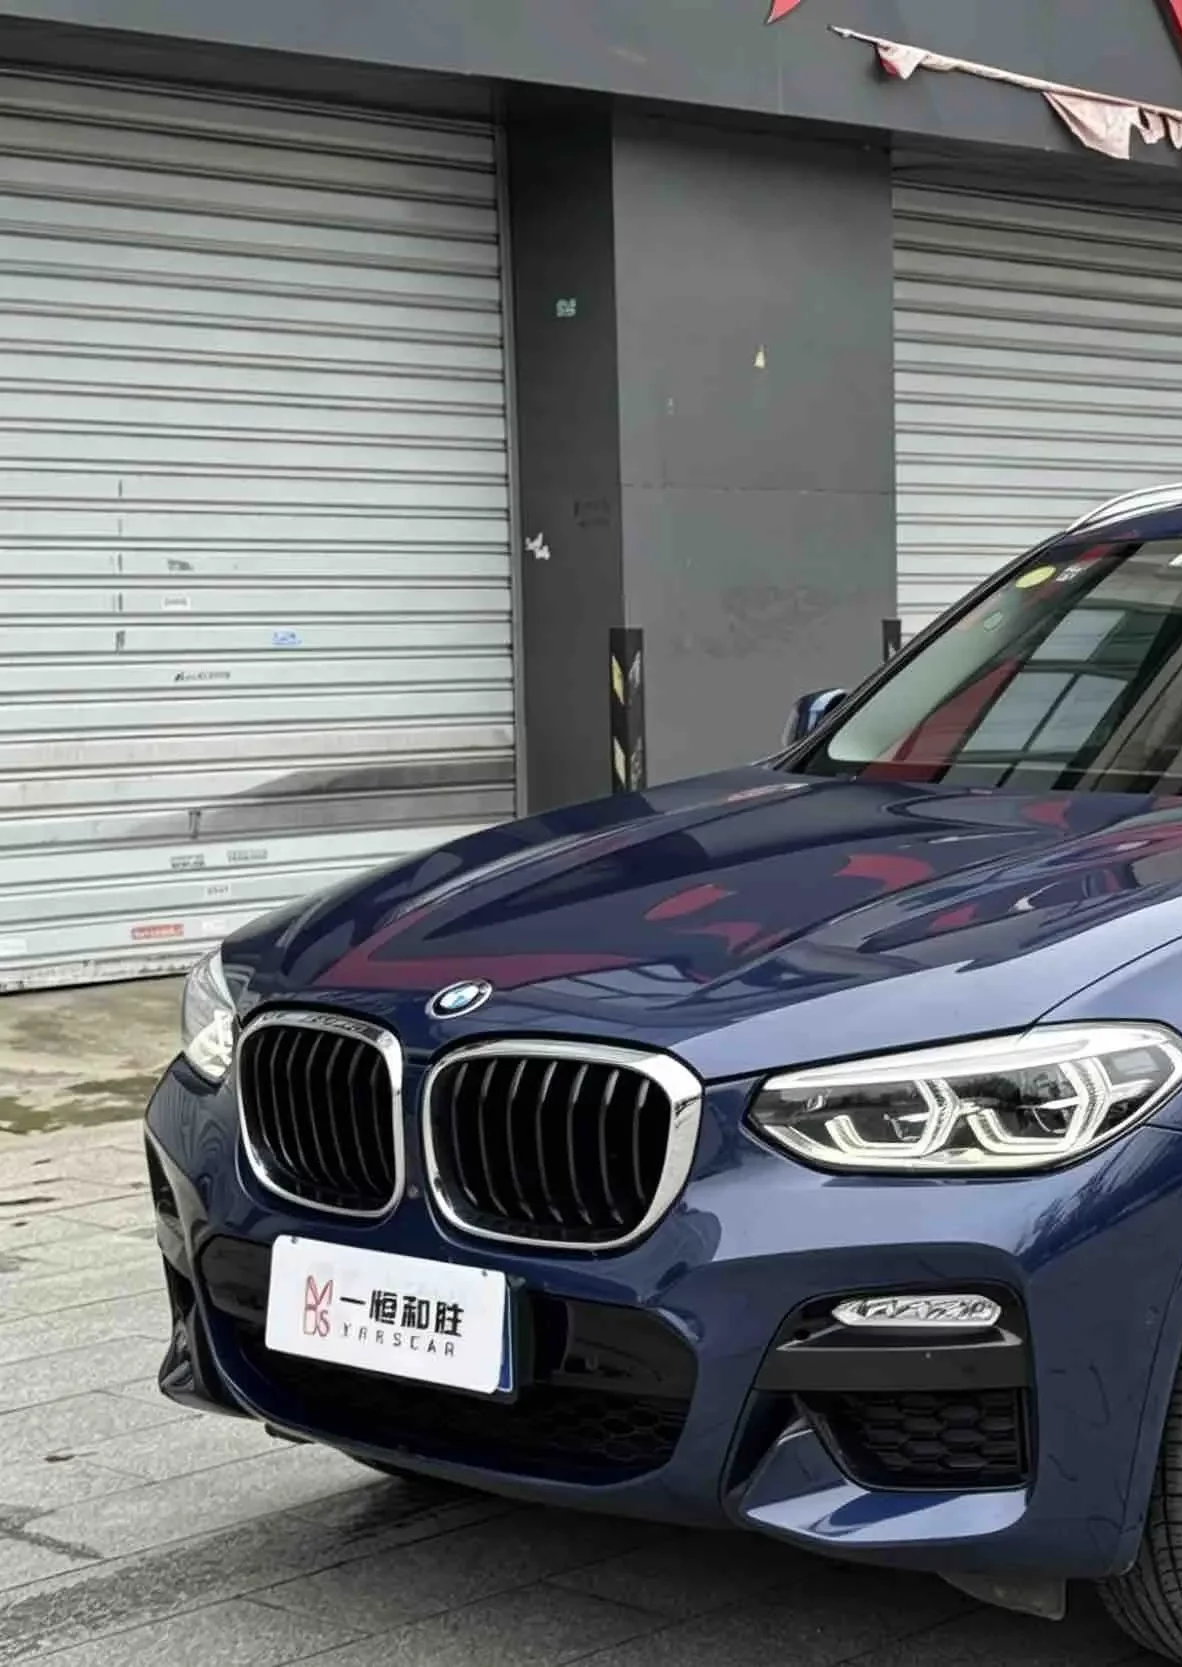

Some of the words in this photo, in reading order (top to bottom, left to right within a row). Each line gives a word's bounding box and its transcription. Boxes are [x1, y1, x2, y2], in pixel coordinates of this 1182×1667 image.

[340, 1289, 465, 1337] 一恒和胜
[342, 1322, 456, 1357] YARSCAR
